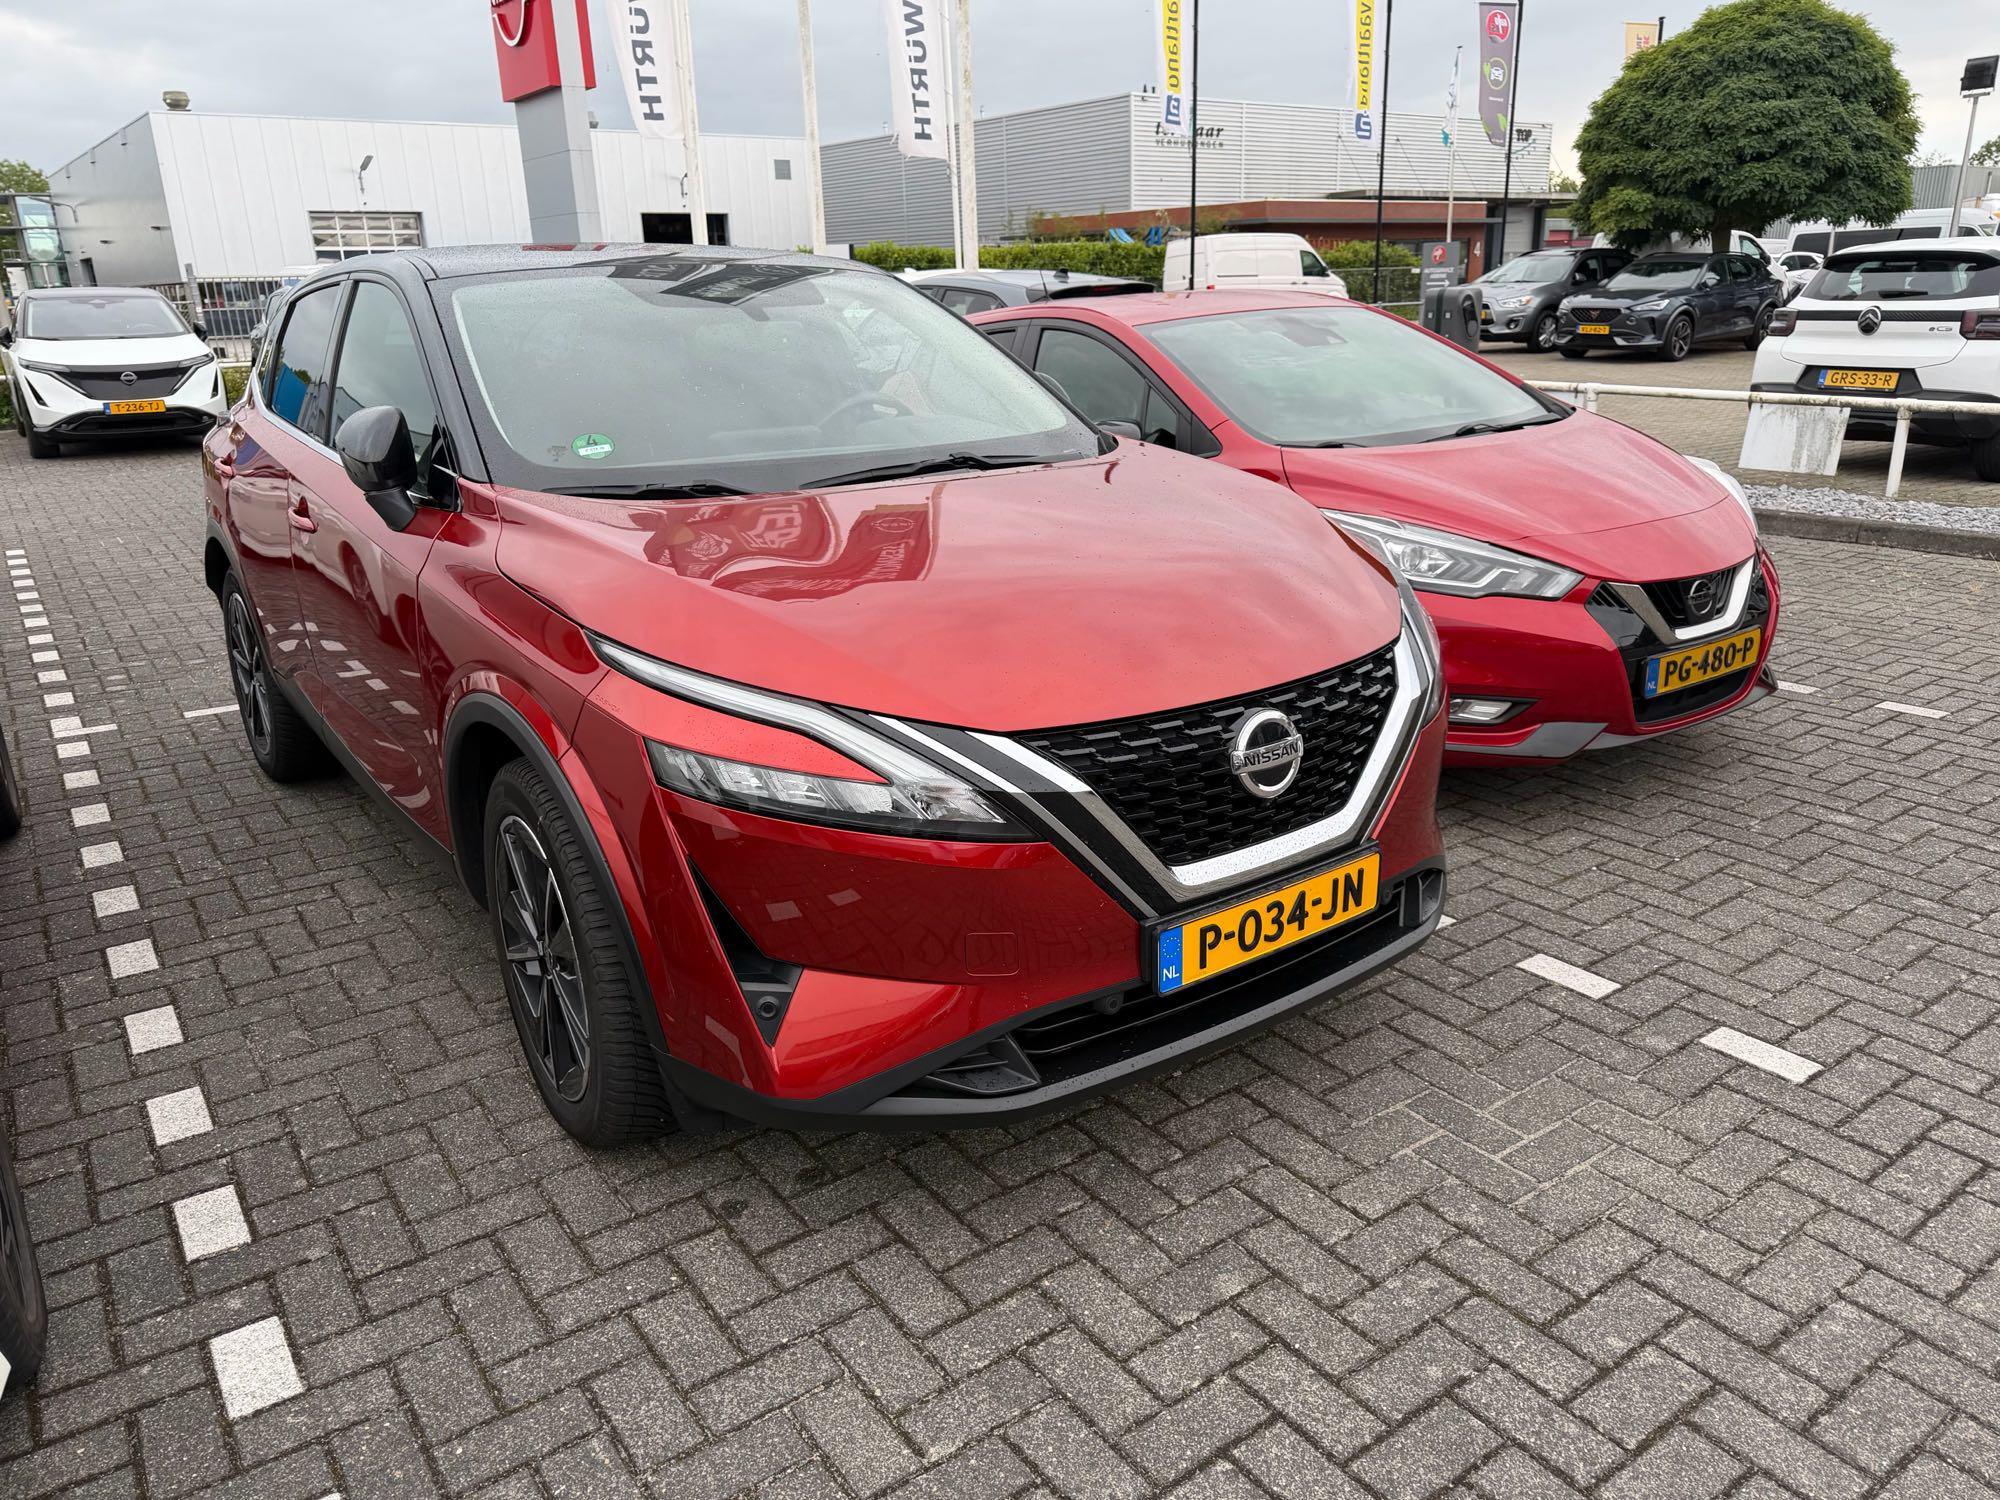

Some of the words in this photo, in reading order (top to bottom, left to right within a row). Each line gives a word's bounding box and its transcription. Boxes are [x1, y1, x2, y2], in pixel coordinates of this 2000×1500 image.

[1473, 241, 1481, 257] 4
[1831, 371, 1892, 387] GRS-33-R
[115, 402, 160, 412] T-236-TJ
[1663, 636, 1755, 688] PG-480-P
[1242, 744, 1300, 768] NISSAN
[1199, 867, 1365, 970] P-034-JN
[1162, 965, 1180, 982] NL
